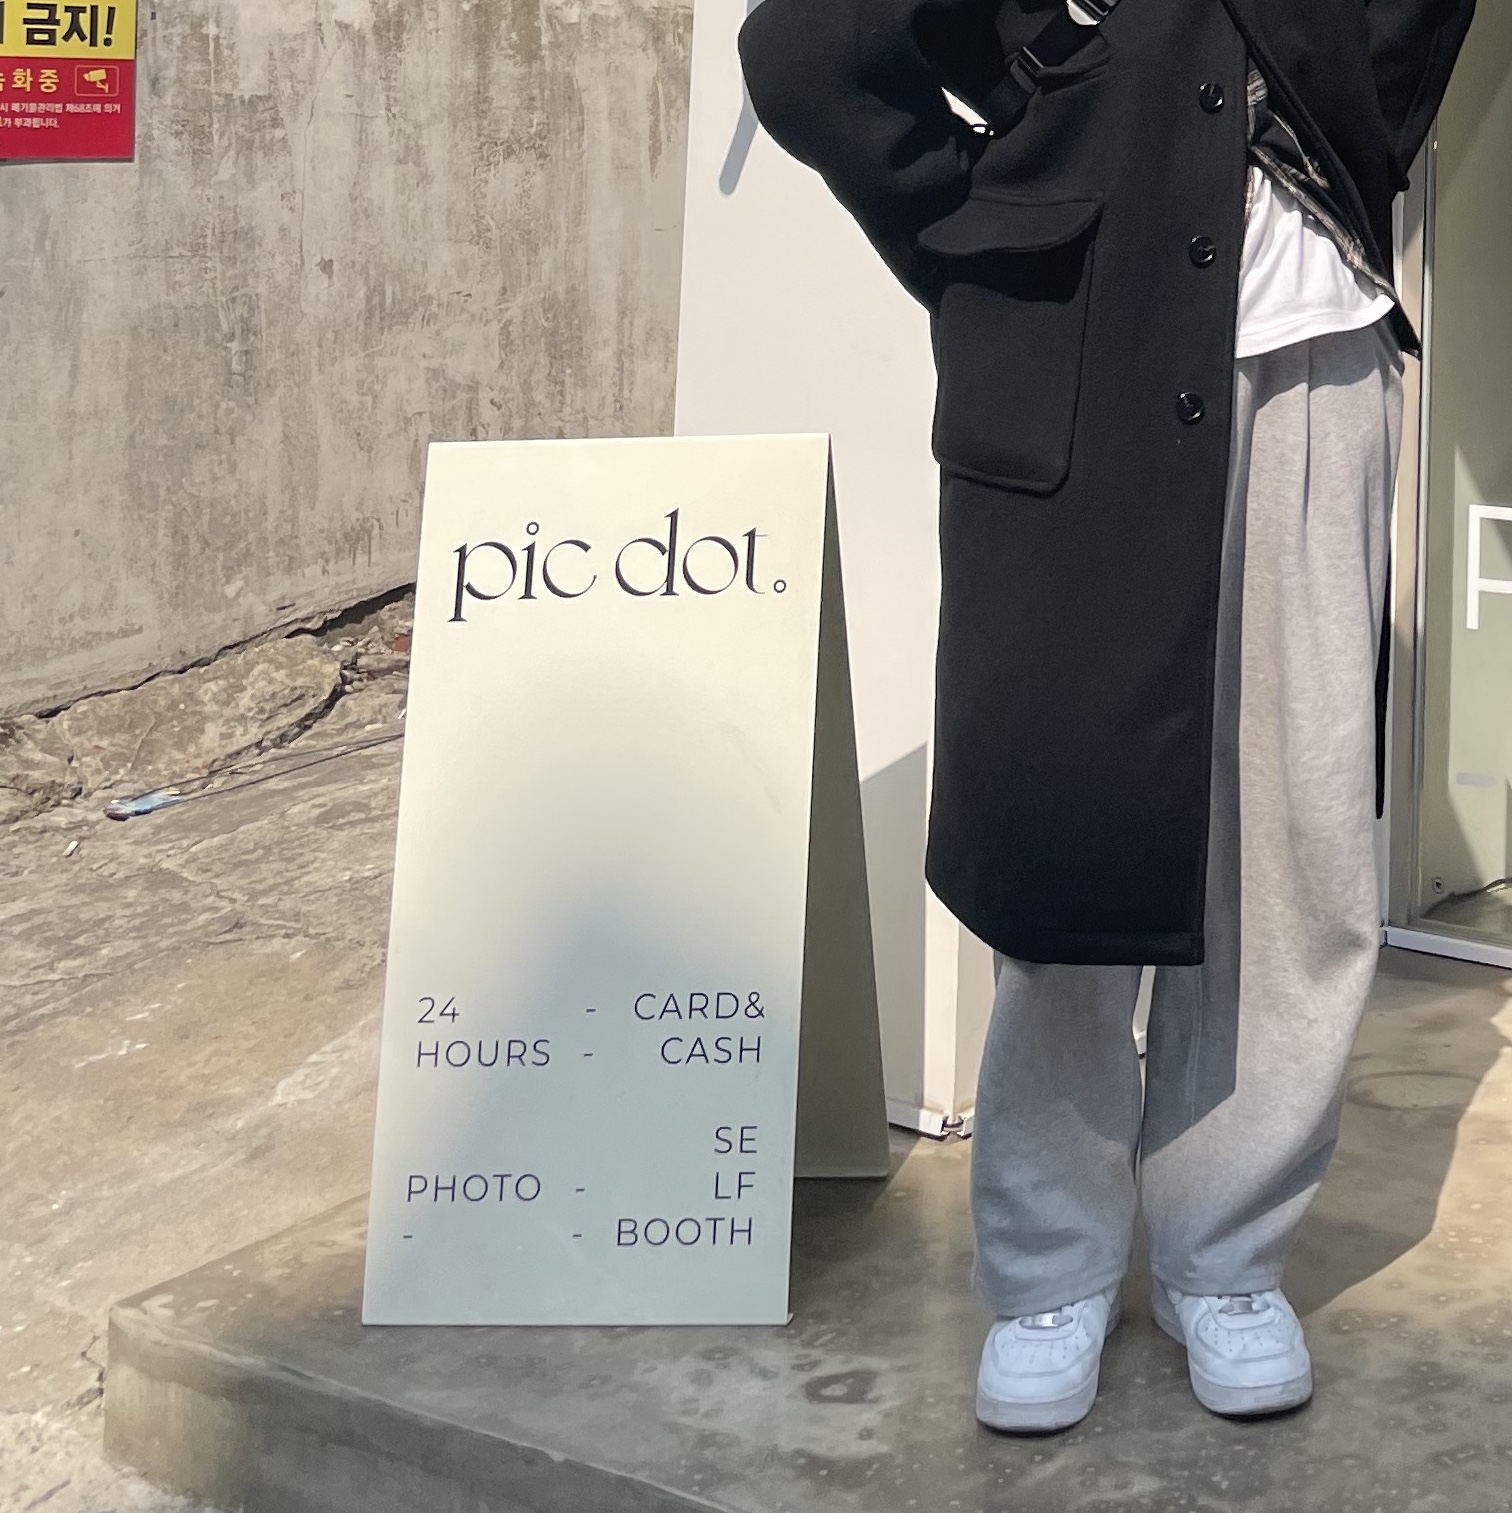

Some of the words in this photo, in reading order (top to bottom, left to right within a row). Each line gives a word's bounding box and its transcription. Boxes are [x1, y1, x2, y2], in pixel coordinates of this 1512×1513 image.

[22, 2, 116, 47] 금지!
[447, 521, 597, 623] pic
[615, 508, 787, 597] dot.
[416, 996, 460, 1024] 24
[633, 991, 766, 1022] CARD&
[416, 1039, 552, 1069] HOURS
[660, 1035, 762, 1065] CASH
[713, 1125, 759, 1155] SE
[406, 1173, 542, 1203] PHOTO
[713, 1171, 757, 1201] LF
[616, 1216, 755, 1246] BOOTH
